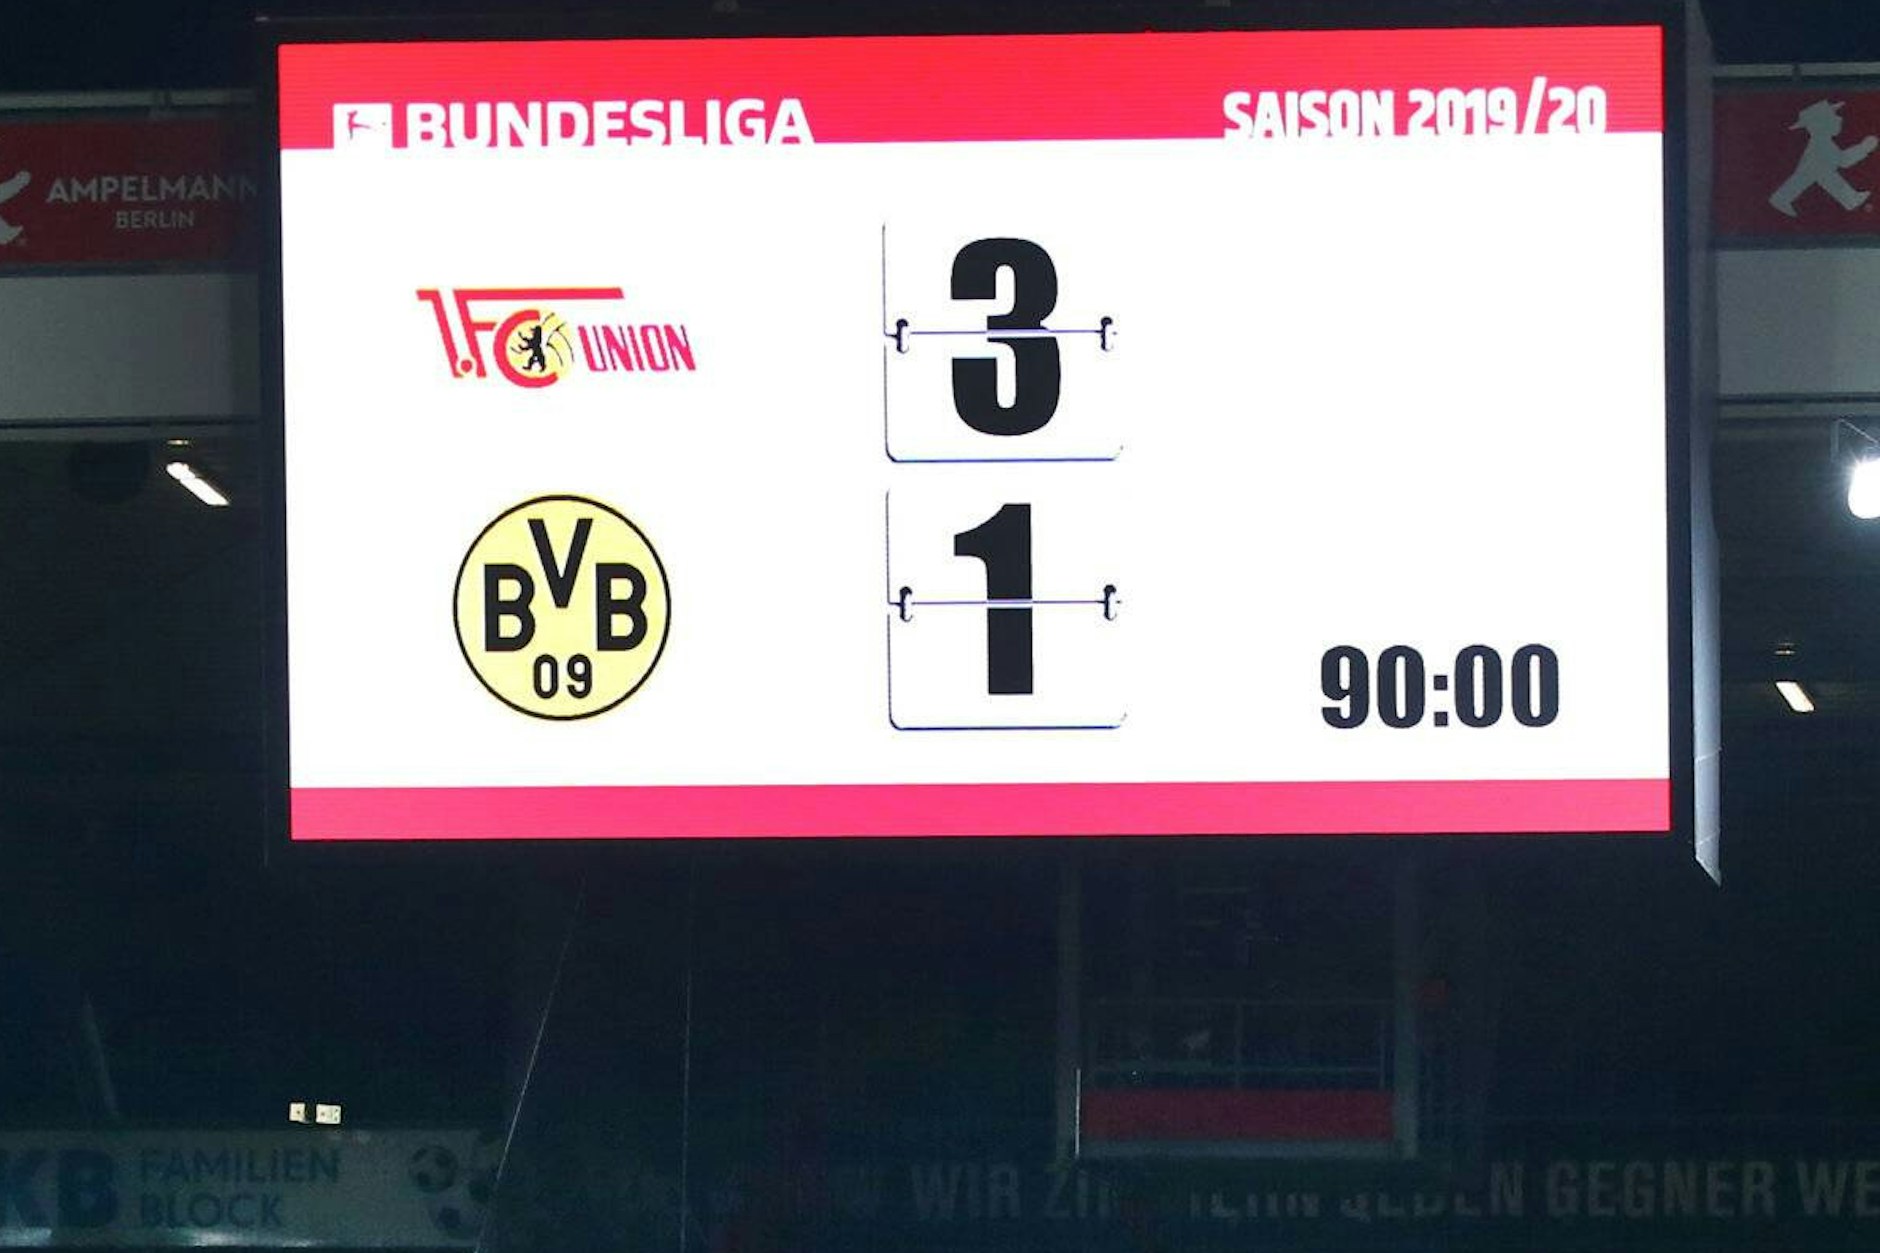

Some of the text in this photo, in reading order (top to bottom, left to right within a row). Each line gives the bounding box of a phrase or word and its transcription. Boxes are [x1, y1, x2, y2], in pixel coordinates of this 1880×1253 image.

[406, 98, 815, 148] BUNDESLIGA
[1222, 77, 1607, 138] SAISON 2019/20
[46, 173, 258, 204] AMPELMANN
[115, 209, 195, 230] BERLIN
[578, 324, 696, 373] UNION
[950, 237, 1061, 436] 3
[483, 518, 649, 652] BVB
[953, 503, 1033, 695] 1
[533, 654, 593, 700] 09
[1320, 644, 1560, 729] 90:00
[143, 1148, 339, 1184] FAMILIEN
[1545, 1160, 1777, 1219] GEGNER
[142, 1194, 283, 1228] BLOCK
